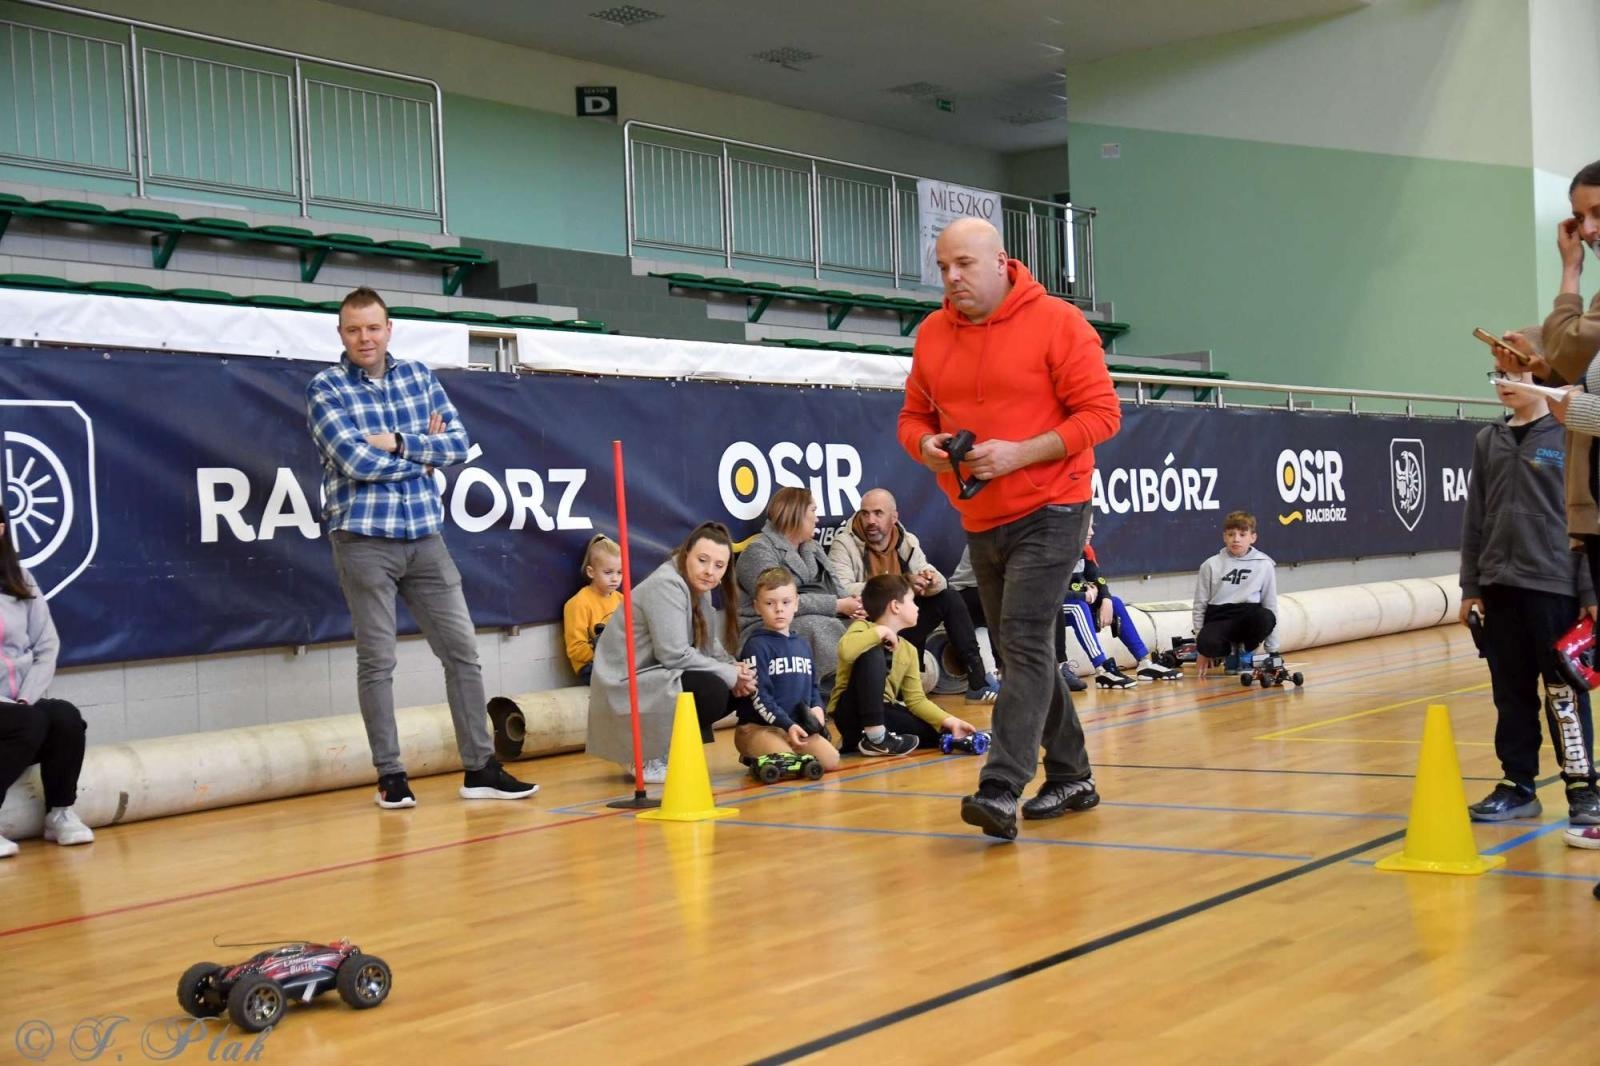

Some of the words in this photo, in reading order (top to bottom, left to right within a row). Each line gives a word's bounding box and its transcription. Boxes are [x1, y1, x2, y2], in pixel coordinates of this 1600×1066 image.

[584, 96, 610, 113] D
[930, 187, 994, 220] MIESZKO
[196, 442, 593, 543] RAÓRZ
[1091, 452, 1220, 515] ACIBÓRZ
[1305, 503, 1347, 523] RACIBÓRZ
[768, 656, 812, 676] BELIEVE
